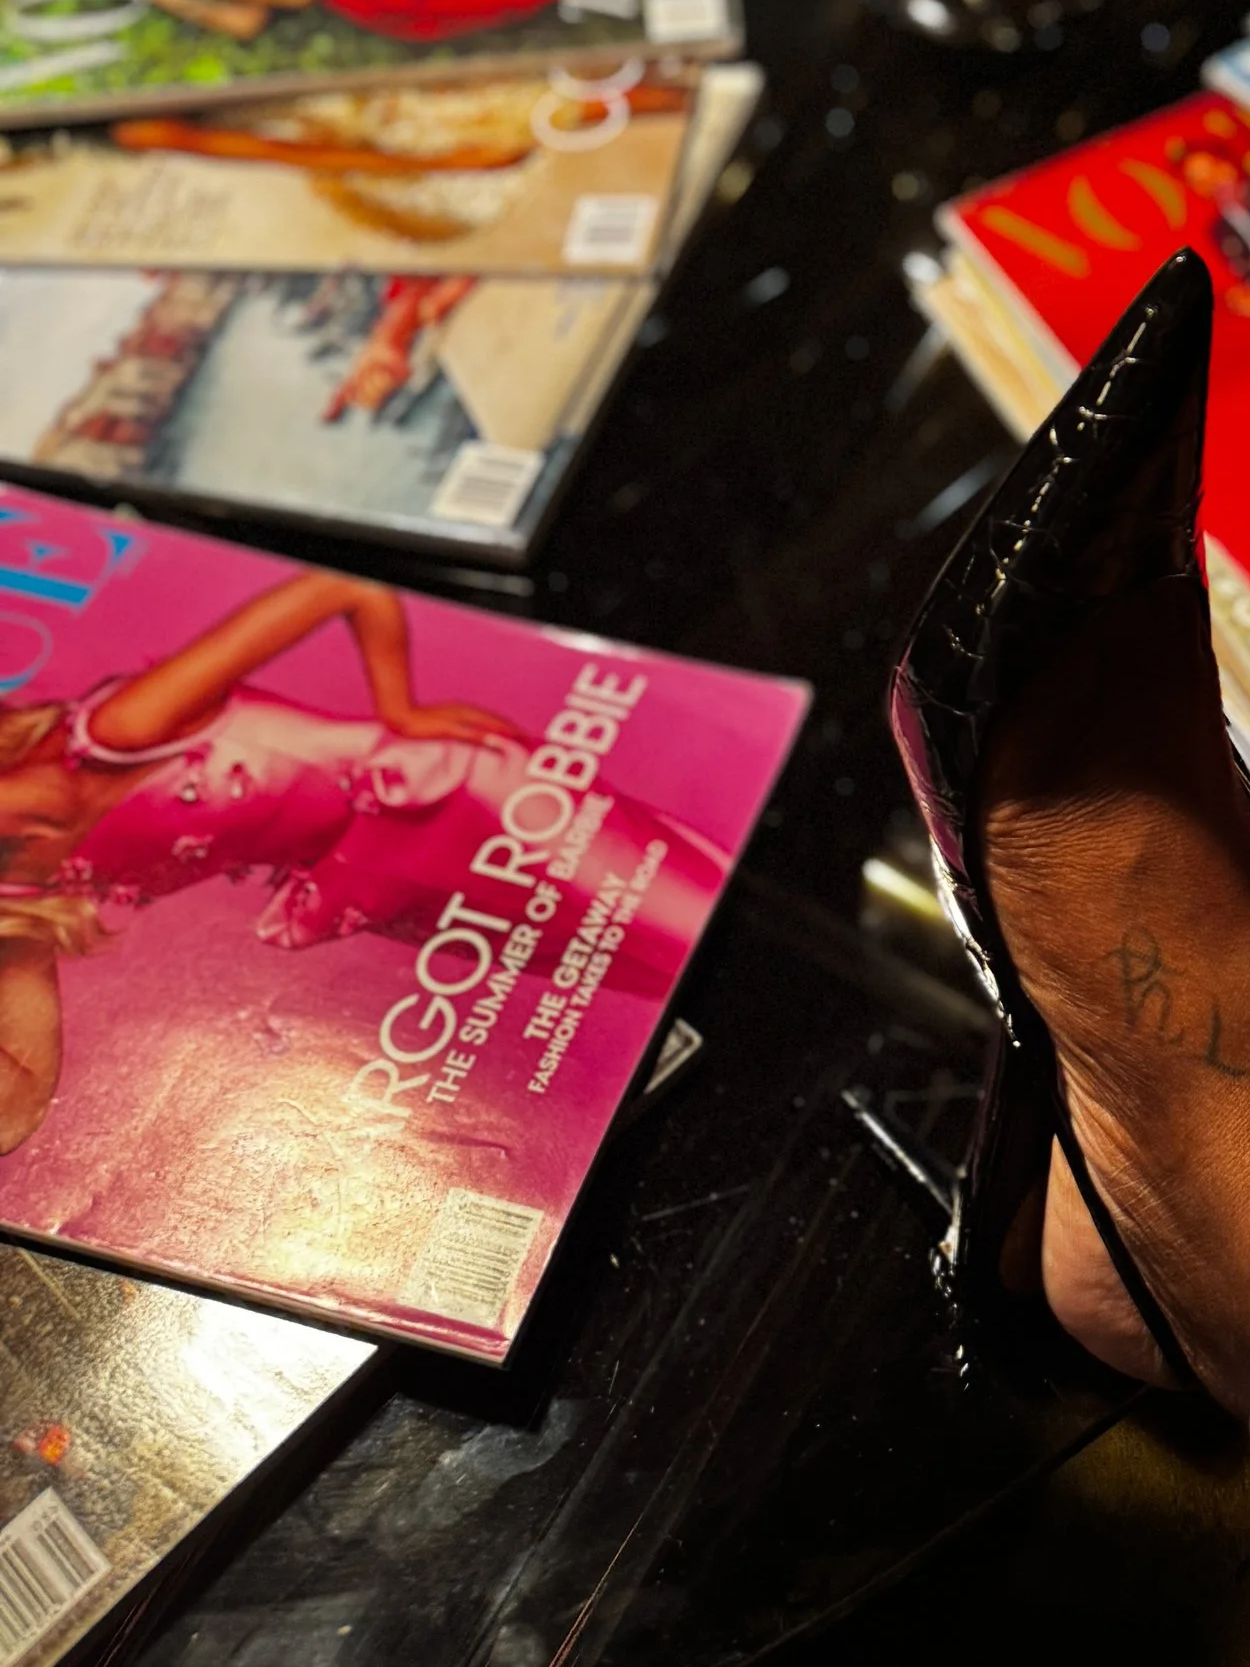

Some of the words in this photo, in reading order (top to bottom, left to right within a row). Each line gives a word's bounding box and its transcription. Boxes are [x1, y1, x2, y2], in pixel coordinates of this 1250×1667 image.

[468, 661, 649, 889] ROBBIE
[426, 1048, 477, 1103] THE
[458, 923, 543, 1047] SUMMER
[525, 880, 563, 923] OF
[545, 790, 615, 882] BARBIE
[598, 923, 626, 952] TO
[611, 891, 643, 926] THE
[522, 990, 568, 1040] THE
[552, 871, 628, 989] GETAWAY
[570, 950, 614, 1009] TAKES
[526, 1008, 584, 1094] FASHION
